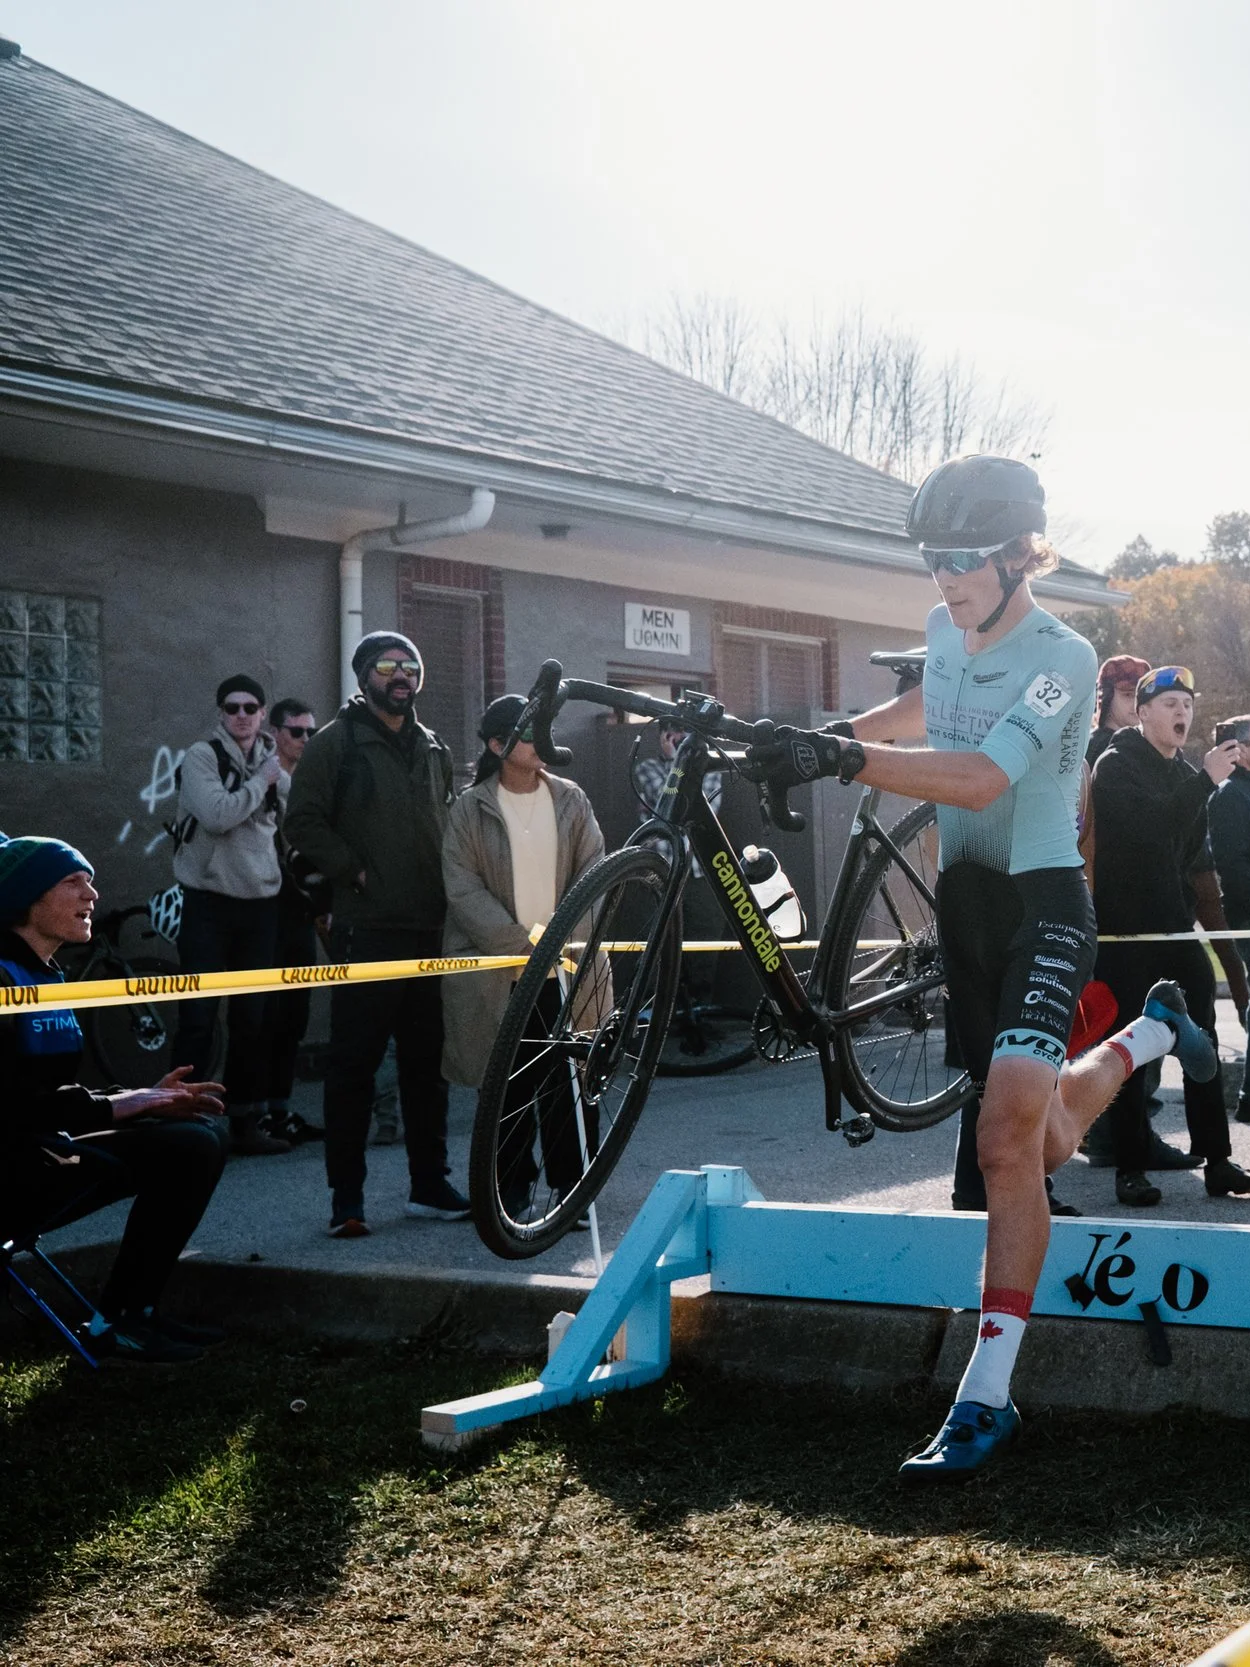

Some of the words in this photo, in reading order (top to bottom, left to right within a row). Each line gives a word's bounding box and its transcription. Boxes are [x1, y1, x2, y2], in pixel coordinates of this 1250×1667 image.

[642, 608, 675, 629] MEN
[1035, 680, 1062, 708] 32
[1005, 717, 1044, 750] solutions
[712, 851, 781, 972] cannondale
[1034, 954, 1077, 973] Blundstone
[1029, 976, 1072, 997] solutions
